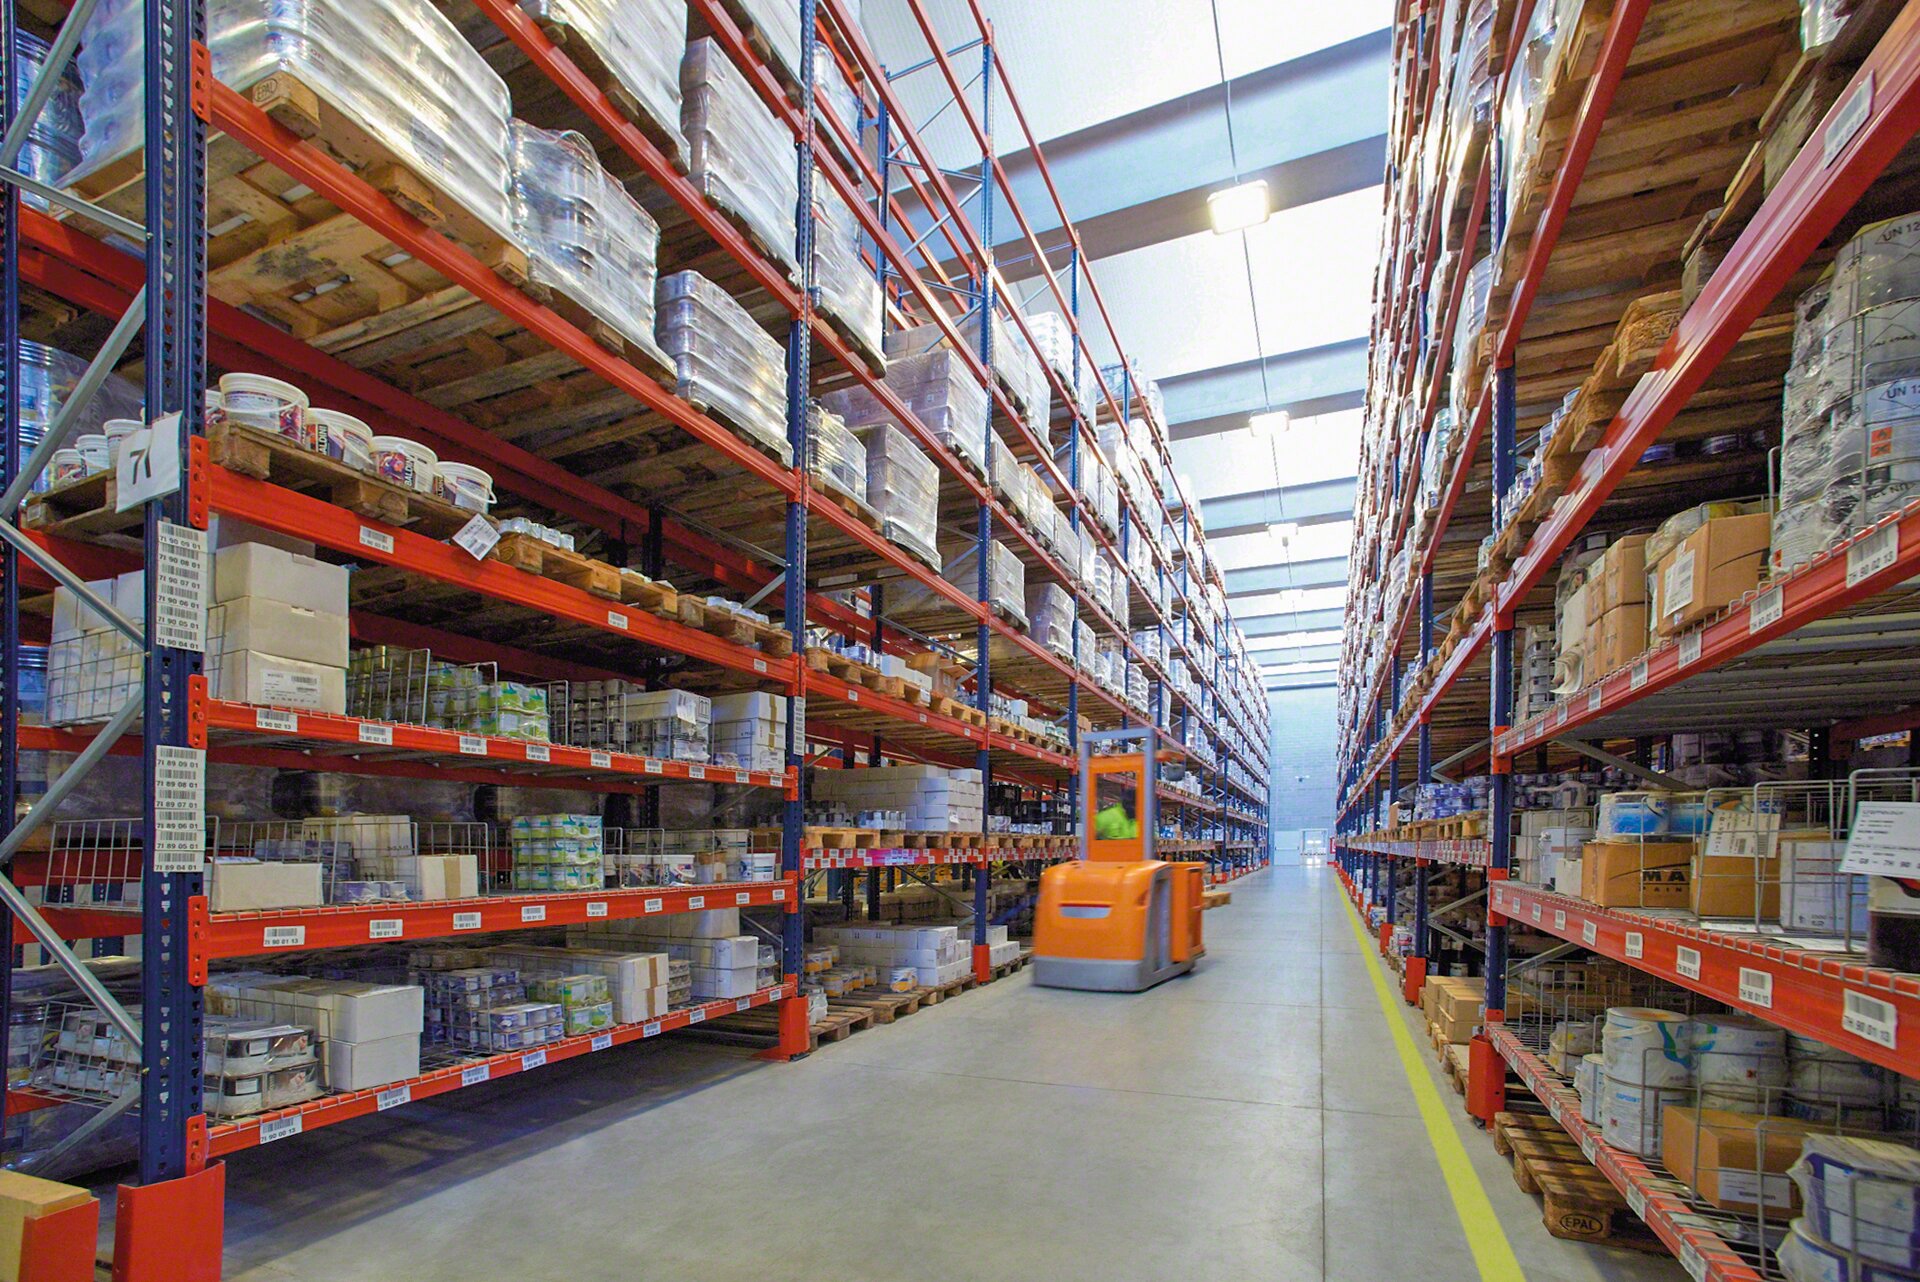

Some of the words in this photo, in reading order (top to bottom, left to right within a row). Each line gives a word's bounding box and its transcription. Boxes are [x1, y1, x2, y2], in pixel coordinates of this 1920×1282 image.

[1882, 226, 1902, 241] UN
[1886, 386, 1907, 399] UN
[169, 537, 179, 545] 90
[168, 556, 178, 564] 90
[1859, 564, 1869, 577] 90
[1871, 557, 1880, 571] 02
[1883, 551, 1893, 564] 13
[1856, 1020, 1865, 1032] 90
[1866, 1024, 1876, 1037] 01
[1565, 1217, 1597, 1232] EPAL
